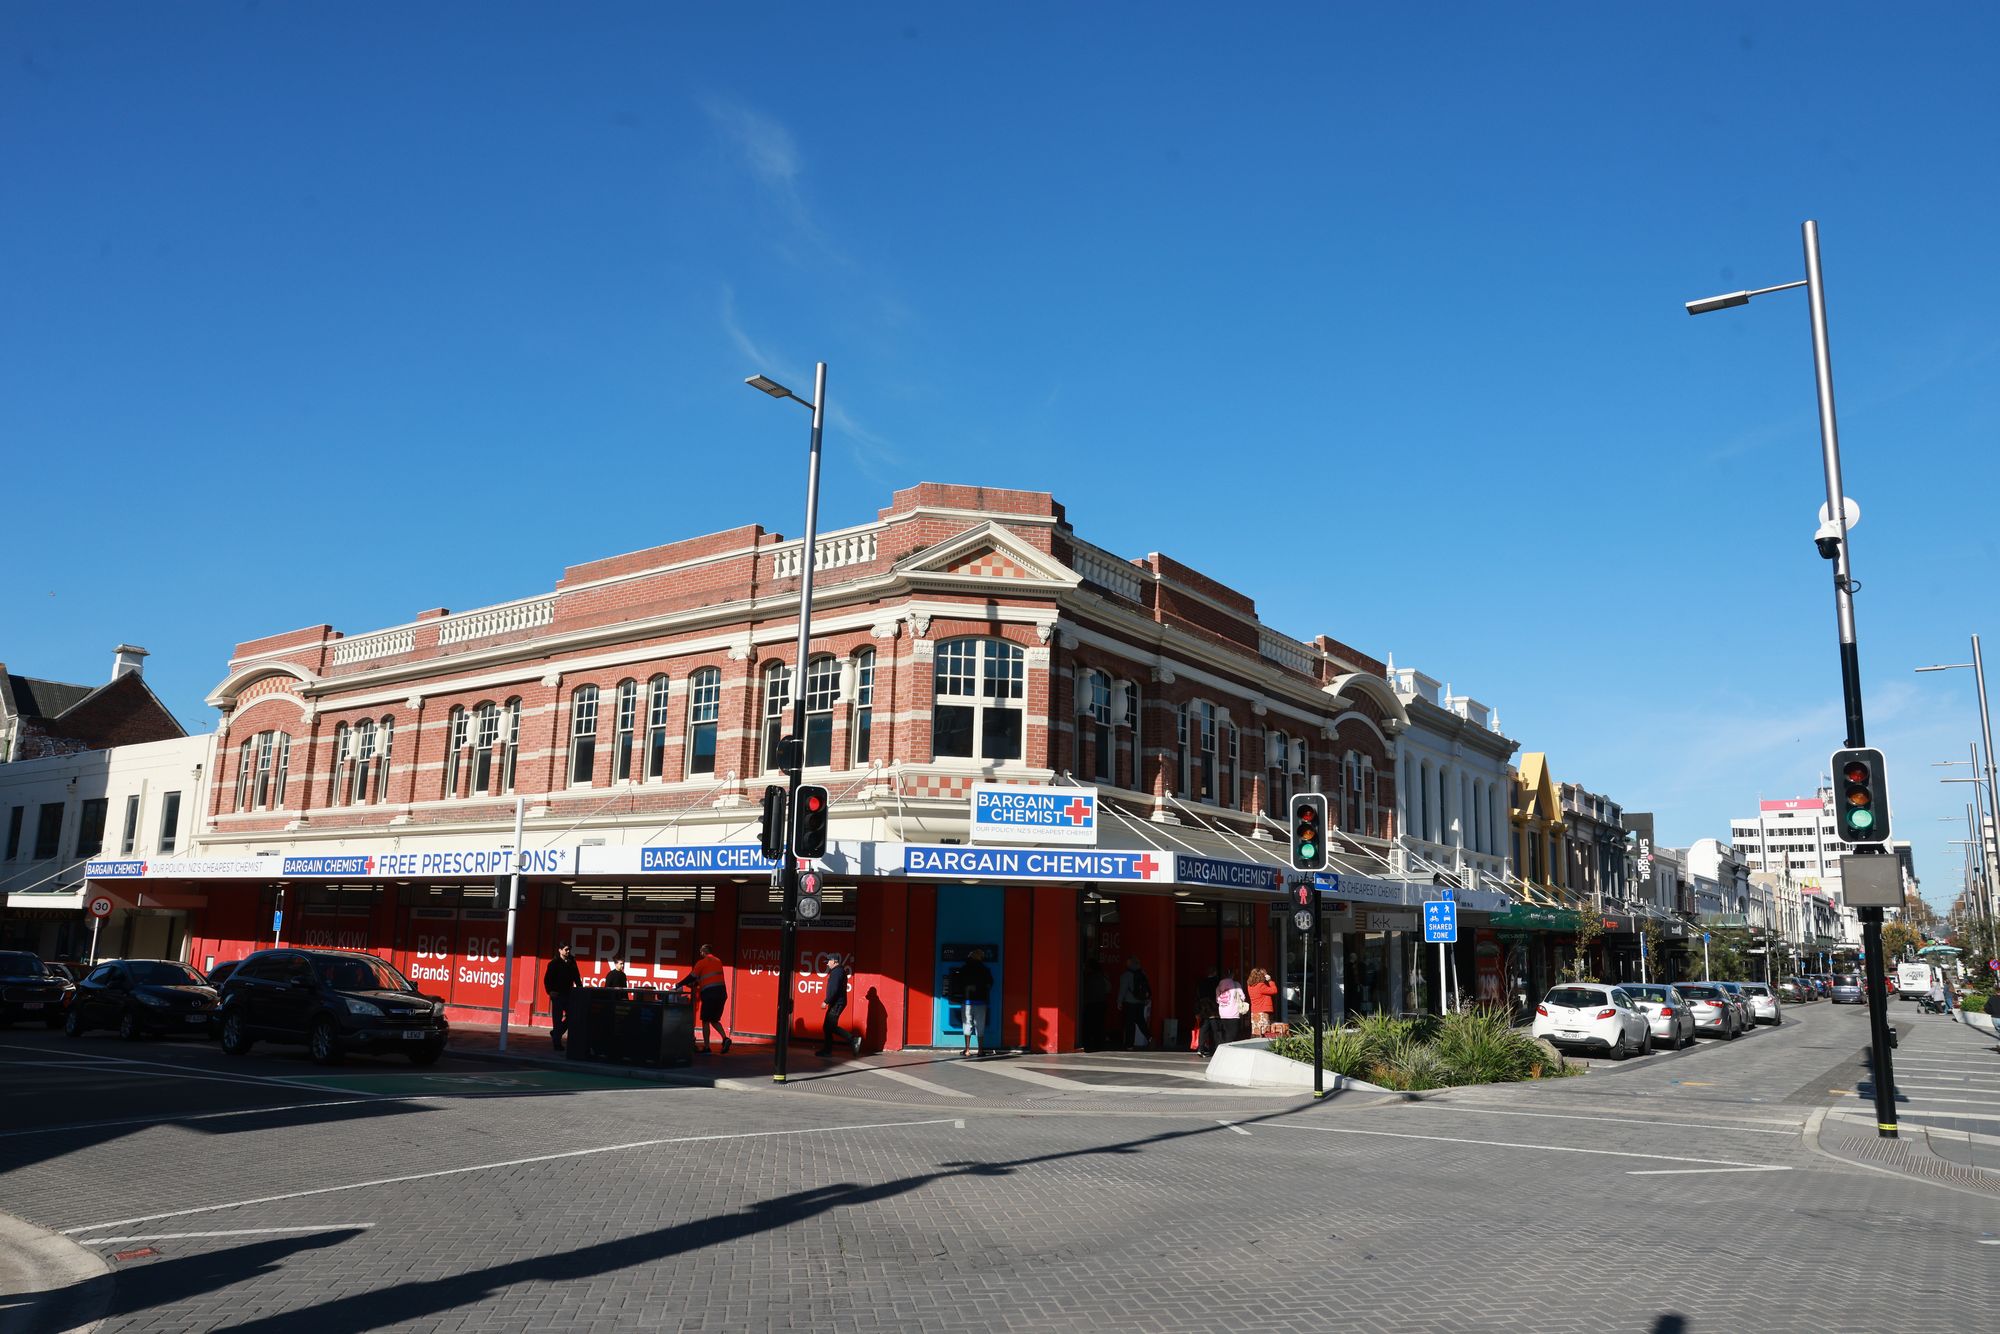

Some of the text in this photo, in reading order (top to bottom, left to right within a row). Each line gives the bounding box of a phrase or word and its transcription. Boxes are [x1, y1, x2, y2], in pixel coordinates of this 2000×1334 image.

[978, 794, 1054, 809] BARGAIN
[991, 808, 1063, 824] CHEMIST
[152, 863, 165, 872] OUR
[202, 862, 235, 872] CHEAPEST
[236, 861, 263, 872] CHEMIST
[285, 859, 363, 873] BARGAIN CHEMIST
[379, 849, 566, 875] FREE PRESCRIPTONS
[644, 850, 712, 868] BARGAIN
[909, 851, 1128, 875] BARGAIN CHEMIST
[1637, 838, 1653, 880] smiggle
[87, 863, 141, 875] BARGAIN CHEMIST
[1179, 860, 1272, 886] BARGAIN CHEMIST
[1347, 882, 1377, 897] CHEAPEST
[1378, 886, 1400, 899] CHEMIST
[95, 902, 109, 911] 30
[304, 929, 368, 950] 100% KIWI
[1432, 931, 1449, 939] ZONE
[416, 935, 448, 959] BIG
[466, 937, 500, 962] BIG
[570, 927, 680, 979] FREE
[411, 963, 449, 981] Brands
[750, 963, 764, 976] UP
[800, 951, 855, 979] 50%
[458, 966, 504, 988] Savings
[798, 980, 824, 994] OFF
